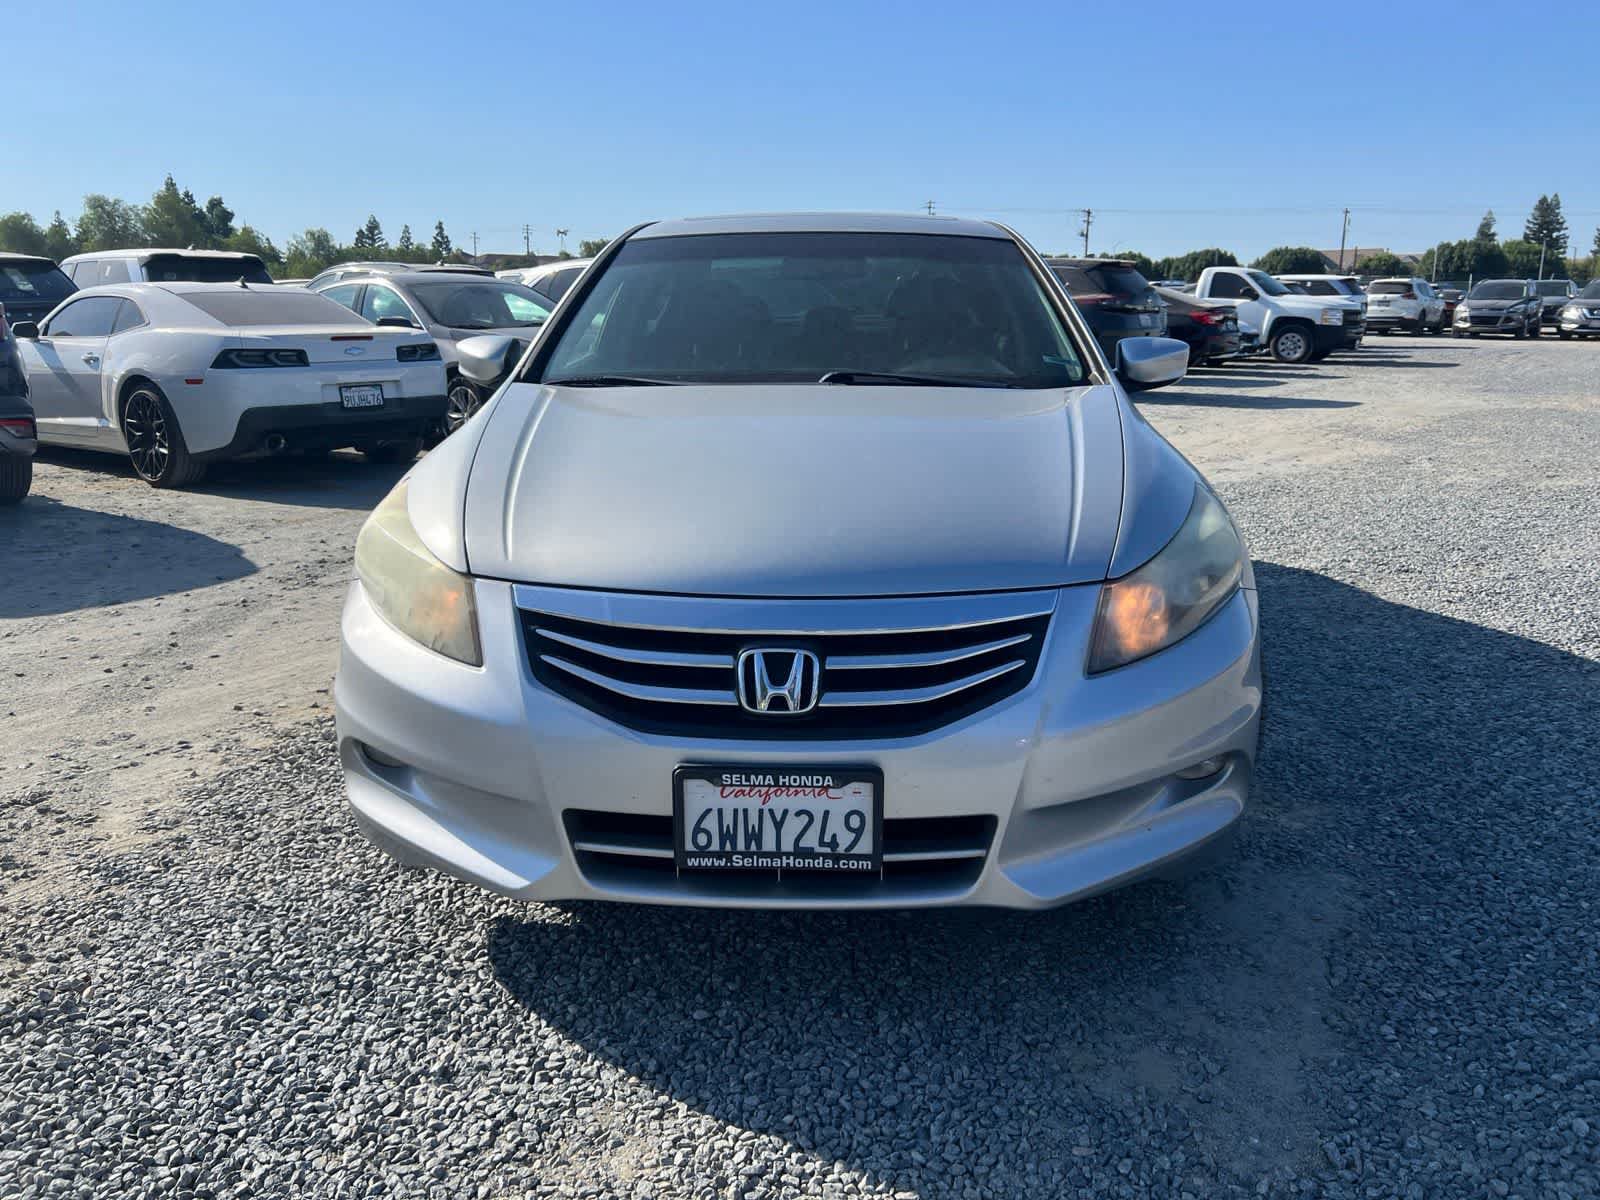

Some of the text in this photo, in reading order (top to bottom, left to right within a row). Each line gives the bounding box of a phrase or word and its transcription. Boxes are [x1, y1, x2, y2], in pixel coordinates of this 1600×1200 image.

[722, 774, 833, 787] SELMA HONDA
[691, 807, 866, 853] 6WWY249
[687, 855, 872, 870] www.SelmaHonda.com
